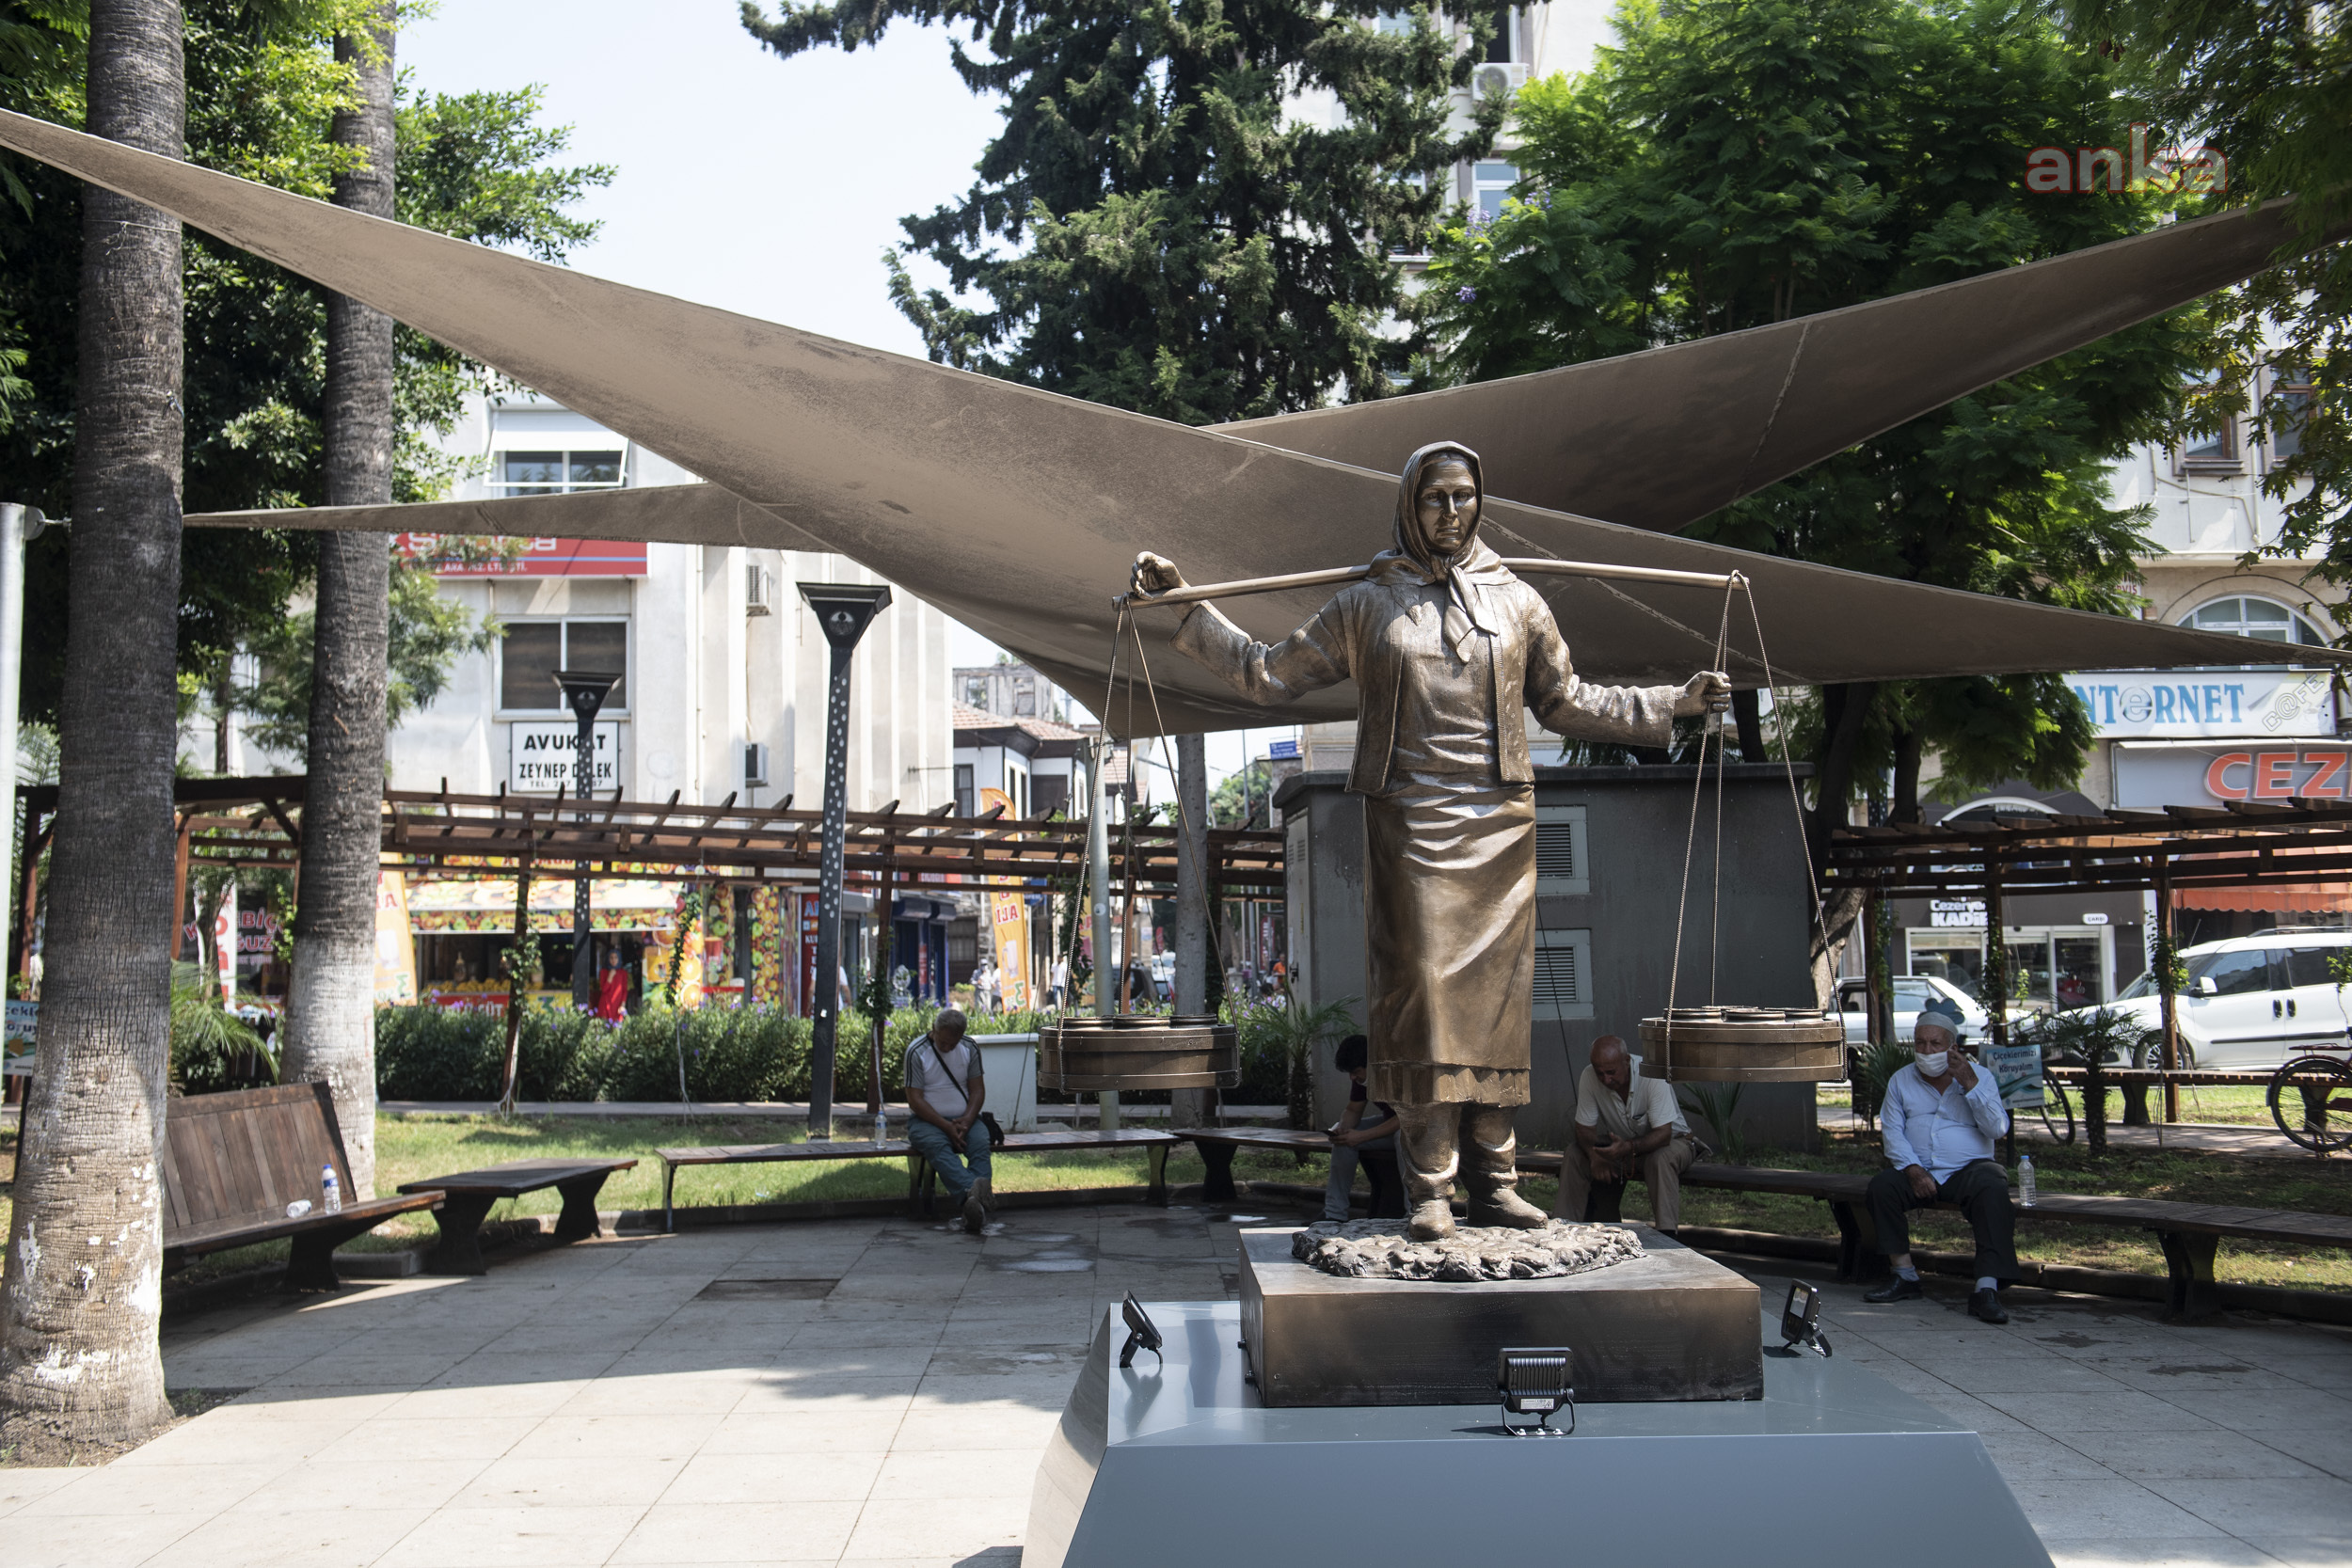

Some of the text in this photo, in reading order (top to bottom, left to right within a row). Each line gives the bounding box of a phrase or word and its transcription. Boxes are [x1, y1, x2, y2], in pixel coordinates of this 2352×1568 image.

[2074, 683, 2245, 724] NTeRNET
[523, 735, 606, 750] AVUKT
[519, 762, 612, 779] ZEYNEP DEK
[2204, 752, 2352, 800] CEZ
